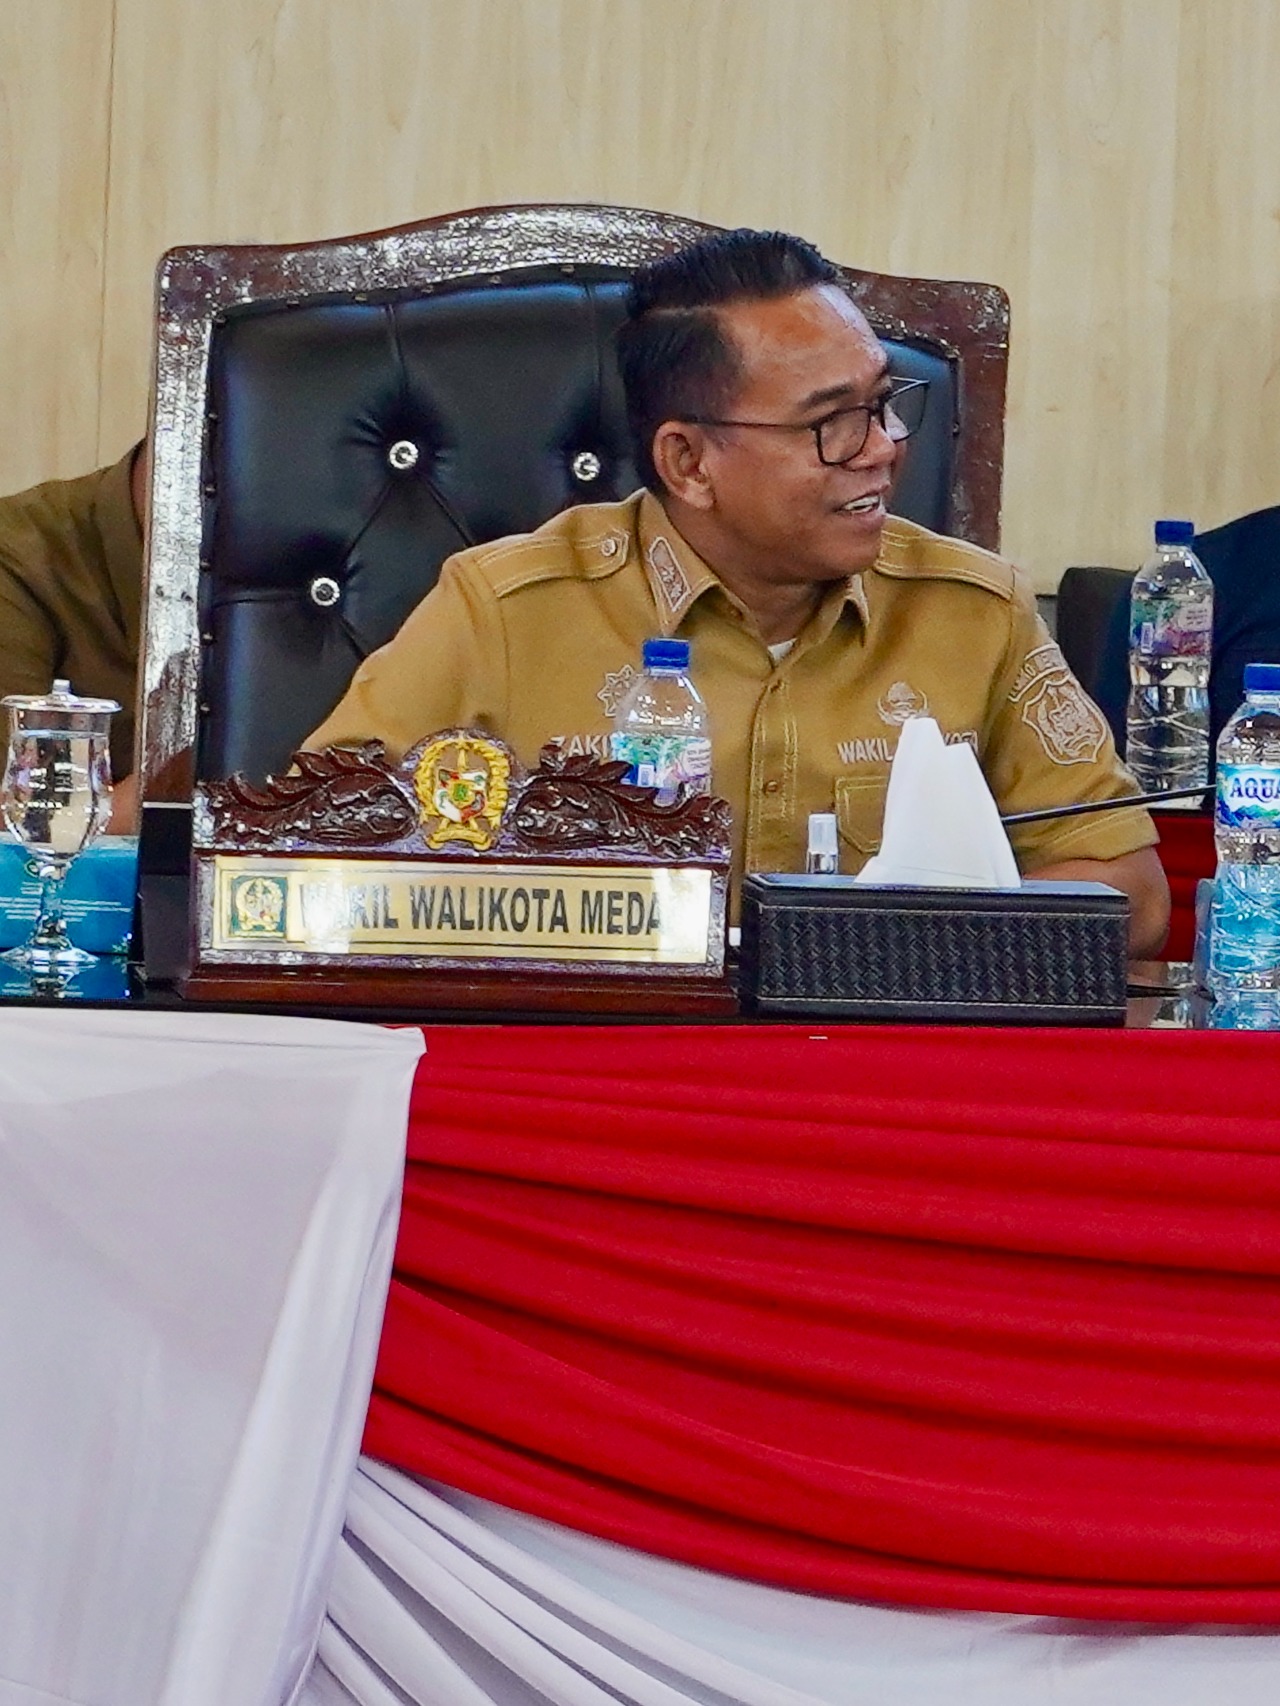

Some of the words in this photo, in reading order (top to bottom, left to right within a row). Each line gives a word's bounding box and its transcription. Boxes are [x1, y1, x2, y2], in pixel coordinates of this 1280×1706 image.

[837, 737, 894, 764] WAKIL
[409, 884, 570, 933] WALIKOTA
[580, 889, 666, 936] MEDA
